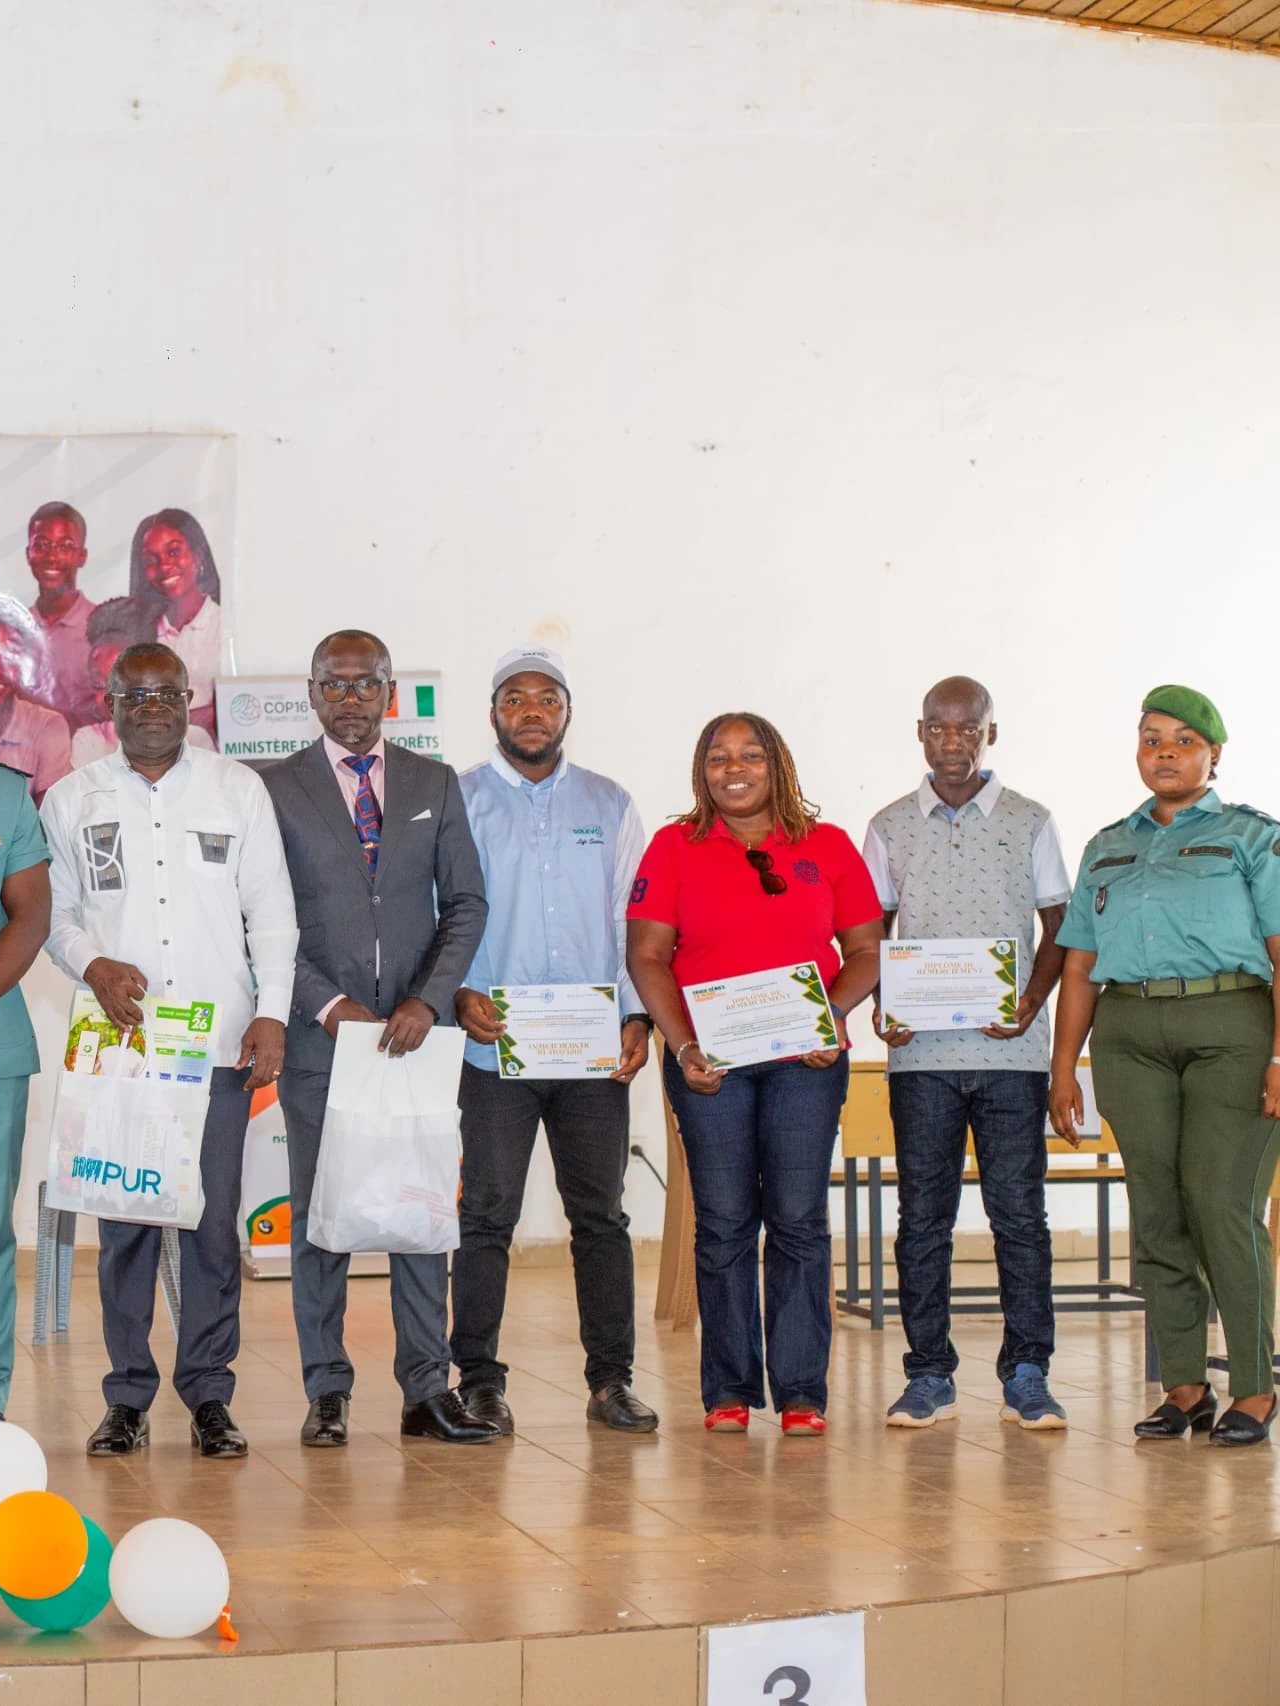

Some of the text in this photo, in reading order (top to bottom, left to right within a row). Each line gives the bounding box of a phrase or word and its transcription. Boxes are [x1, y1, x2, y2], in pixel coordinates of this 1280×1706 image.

[264, 701, 309, 714] COP16
[225, 738, 297, 755] MINISTÈRE
[101, 1161, 162, 1195] PUR
